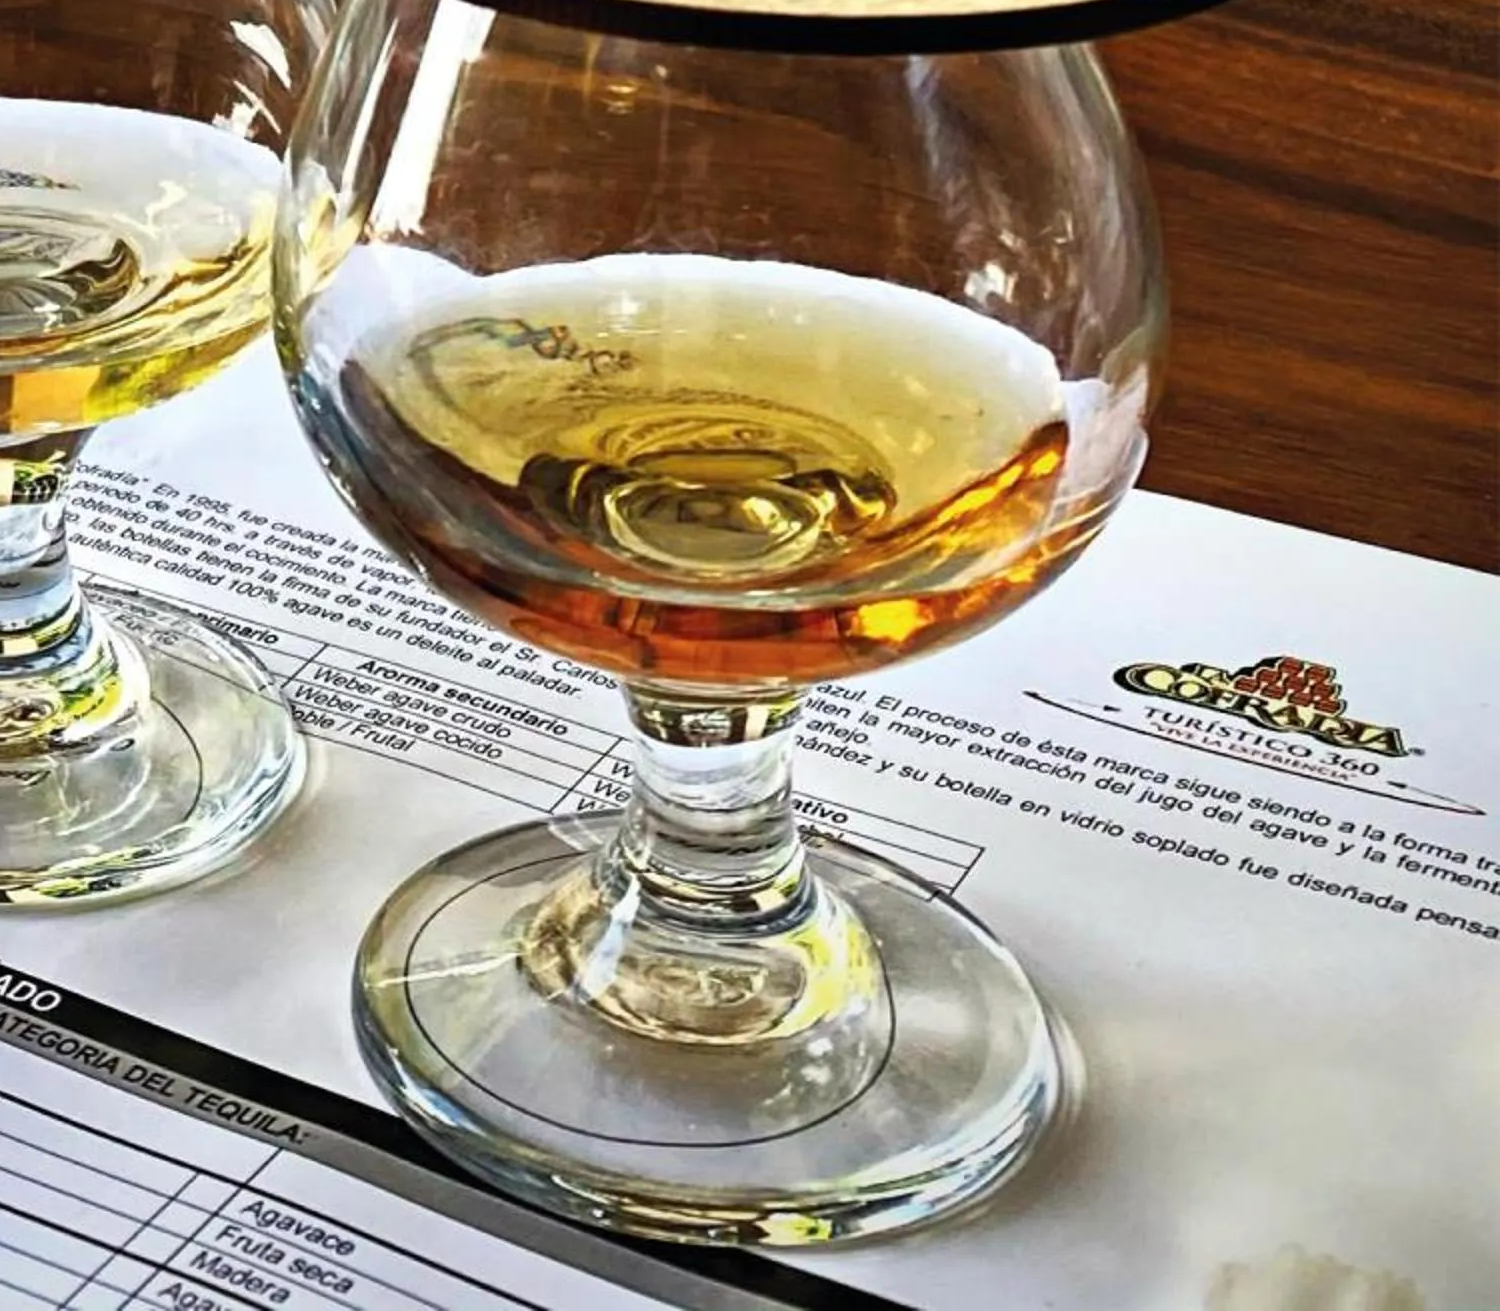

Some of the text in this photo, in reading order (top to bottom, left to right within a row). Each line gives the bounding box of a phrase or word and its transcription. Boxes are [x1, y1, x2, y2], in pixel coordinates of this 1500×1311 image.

[146, 500, 169, 512] de
[176, 508, 201, 521] 40
[244, 531, 259, 540] a
[264, 535, 322, 560] través
[327, 556, 355, 568] de
[153, 483, 179, 498] En
[238, 510, 268, 525] fue
[272, 522, 337, 546] creada
[340, 539, 358, 552] la
[72, 497, 148, 524] obtenido
[151, 519, 221, 547] durante
[224, 543, 245, 553] el
[356, 580, 382, 595] La
[385, 590, 447, 615] marca
[89, 518, 117, 533] las
[121, 527, 192, 556] botellas
[196, 551, 254, 575] tienen
[258, 569, 277, 583] la
[282, 576, 331, 599] firma
[335, 594, 361, 607] de
[366, 603, 392, 617] su
[396, 611, 487, 646] fundador
[489, 642, 512, 654] el
[552, 660, 618, 690] Carlos
[154, 559, 226, 585] calidad
[228, 580, 279, 603] 100%
[283, 598, 344, 623] agave
[348, 617, 372, 631] es
[376, 626, 403, 640] un
[407, 634, 473, 662] deleite
[477, 657, 501, 670] al
[295, 684, 503, 759] Weber agave cocido
[314, 666, 511, 739] Weber agave crudo
[356, 661, 568, 736] Arorma secundario
[351, 723, 416, 752] Frutal
[1144, 706, 1380, 776] TURÍSTICO 360
[859, 711, 880, 727] la
[888, 721, 960, 748] mayor
[967, 742, 1087, 784] extracción
[1095, 778, 1135, 796] del
[1136, 787, 1193, 812] jugo
[1202, 805, 1242, 825] del
[1250, 819, 1328, 847] agave
[1335, 842, 1355, 856] y
[1362, 846, 1386, 863] la
[875, 695, 902, 711] El
[902, 705, 996, 738] proceso
[1000, 731, 1031, 748] de
[1037, 739, 1088, 764] ésta
[1093, 757, 1169, 784] marca
[1174, 778, 1242, 803] sigue
[1248, 797, 1331, 827] siendo
[1338, 822, 1355, 833] a
[1362, 825, 1386, 842] la
[1393, 833, 1468, 864] forma
[876, 759, 894, 774] y
[898, 765, 930, 782] su
[934, 773, 1012, 807] botella
[1019, 800, 1051, 817] en
[1060, 810, 1124, 837] vidrio
[1132, 831, 1230, 866] soplado
[1238, 856, 1279, 881] fue
[1288, 872, 1408, 913] diseñada
[1416, 907, 1500, 939] pensa
[127, 1063, 189, 1096] DEL
[183, 1087, 310, 1144] TEQUILA:
[216, 1225, 354, 1294] Fruta seca
[240, 1200, 355, 1256] Agavace
[190, 1251, 291, 1304] Madera
